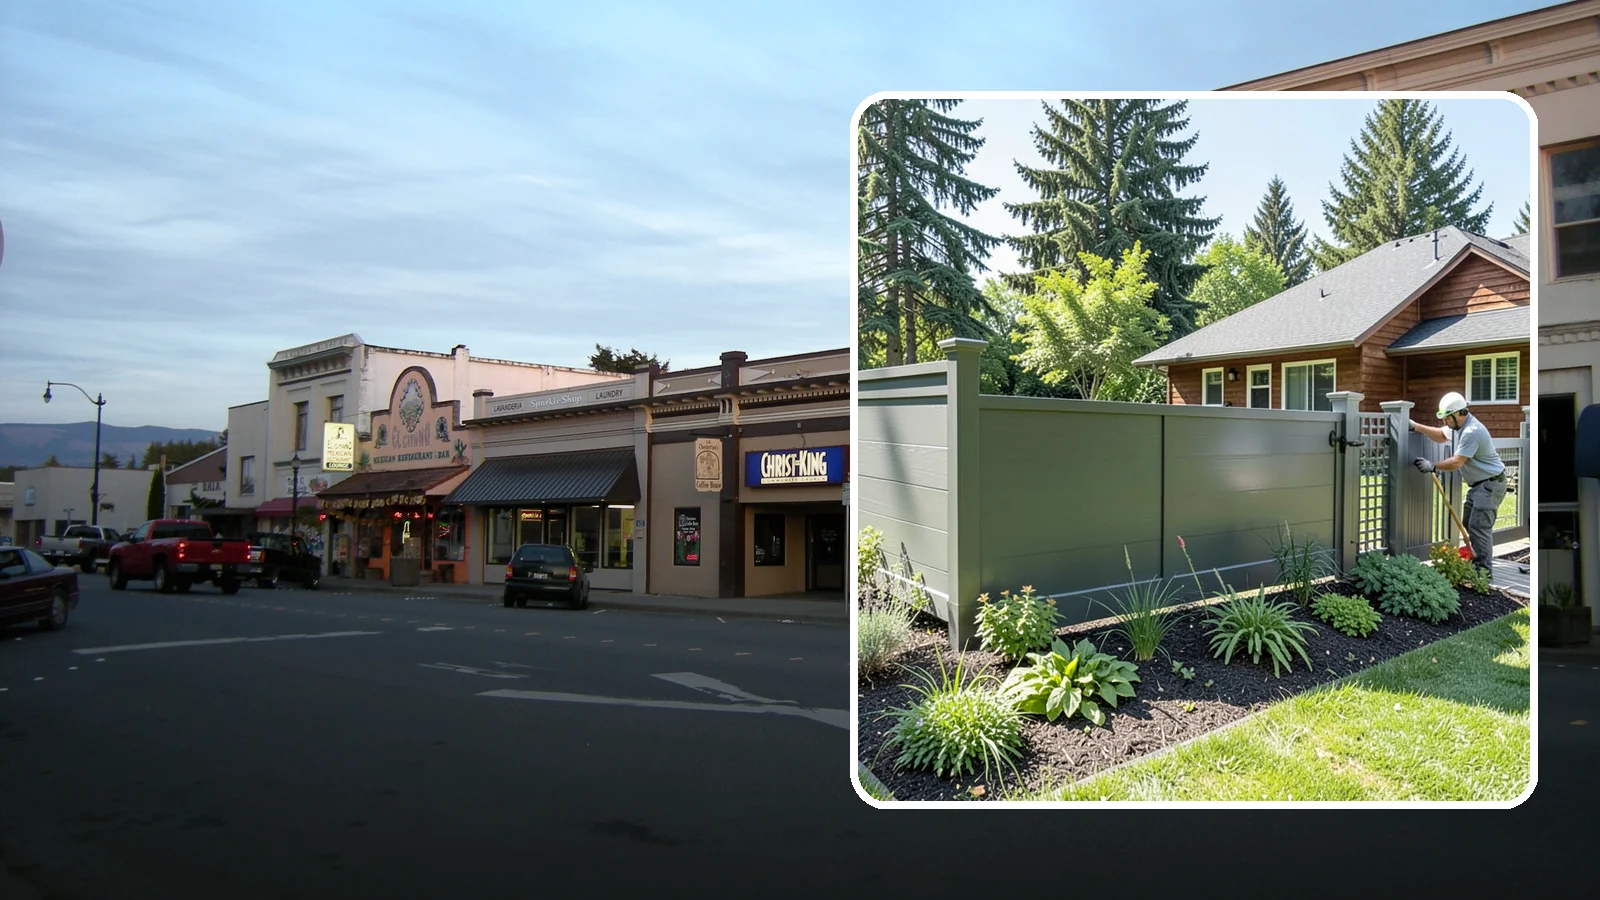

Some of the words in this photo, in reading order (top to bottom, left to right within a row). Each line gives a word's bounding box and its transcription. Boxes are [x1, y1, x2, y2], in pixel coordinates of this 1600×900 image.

[493, 402, 523, 413] LAVANDERIA
[530, 396, 560, 409] Sparkle
[562, 394, 582, 404] Shop
[595, 389, 623, 400] LAUNDRY
[374, 454, 396, 464] MEXICAN
[397, 451, 433, 462] RESTAURANT
[438, 450, 450, 459] BAR
[696, 480, 709, 489] Coffee
[710, 480, 722, 488] House
